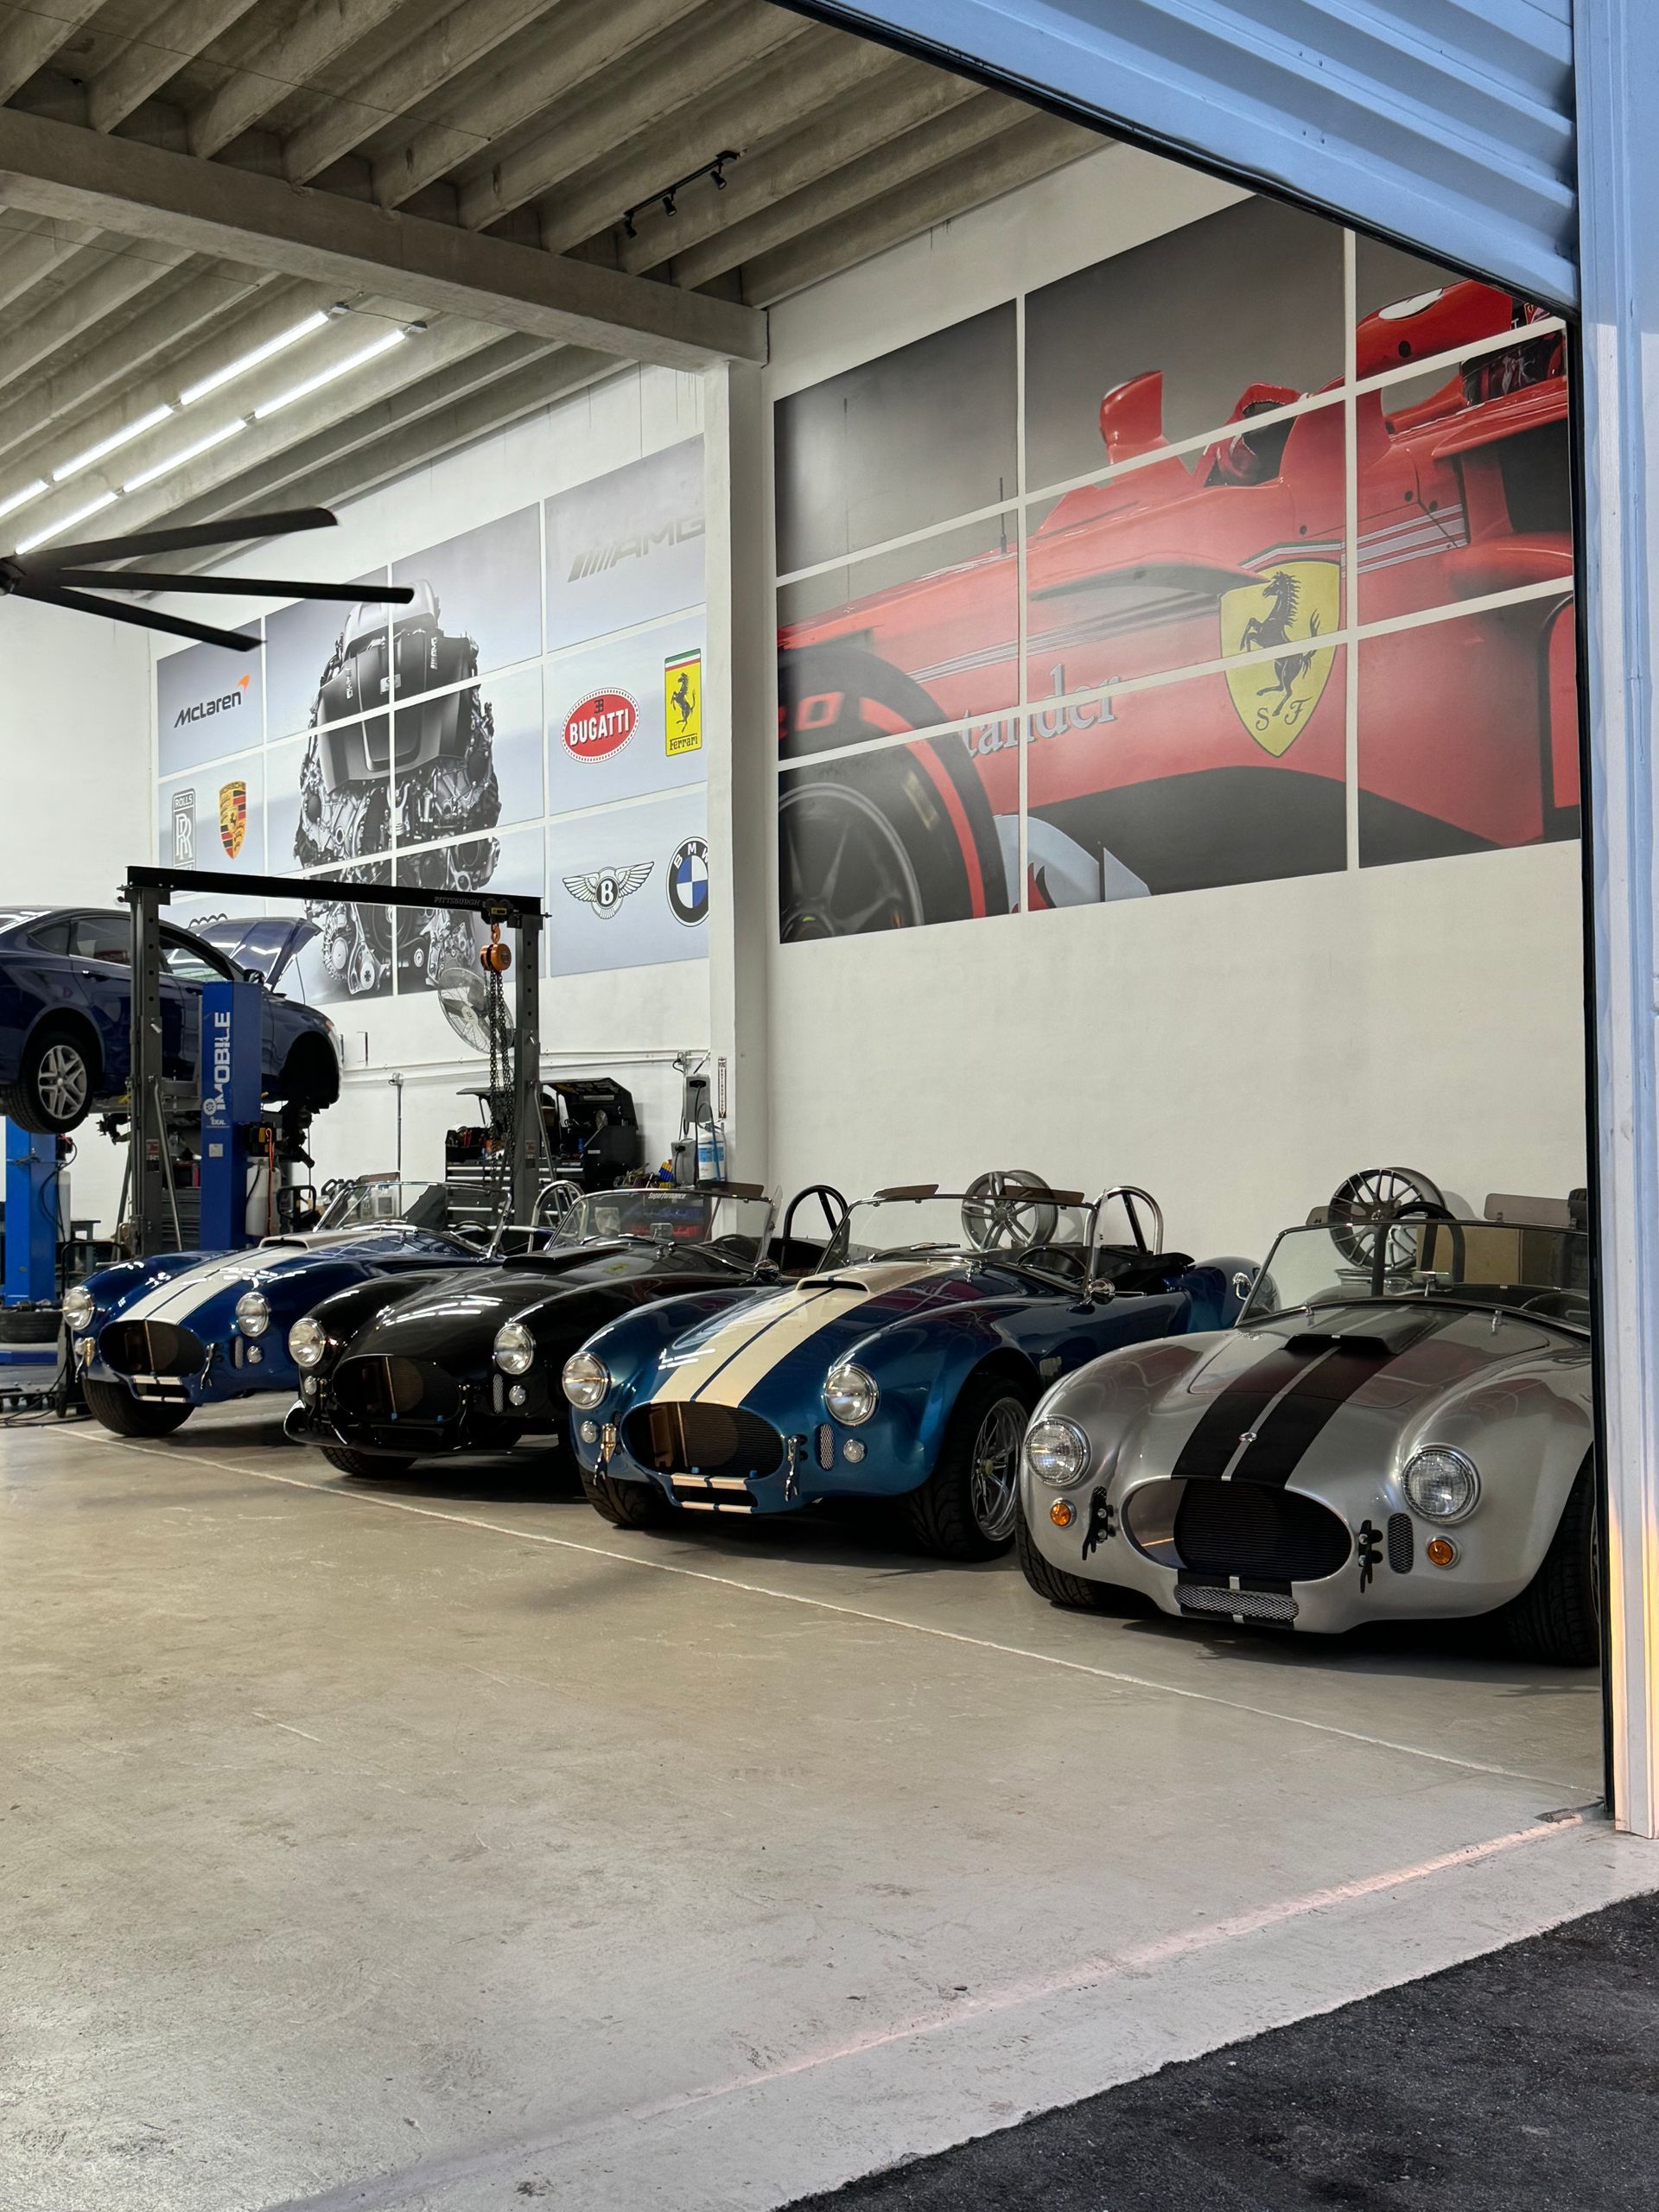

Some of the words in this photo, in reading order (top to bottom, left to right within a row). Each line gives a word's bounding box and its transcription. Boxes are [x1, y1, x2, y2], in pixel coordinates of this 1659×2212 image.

[174, 691, 242, 728] McLaren
[1255, 707, 1269, 732] S
[1284, 696, 1313, 726] F
[569, 708, 631, 747] BUGATTI
[669, 734, 698, 751] Ferrari
[175, 795, 193, 810] ROLLS
[600, 880, 614, 906] B
